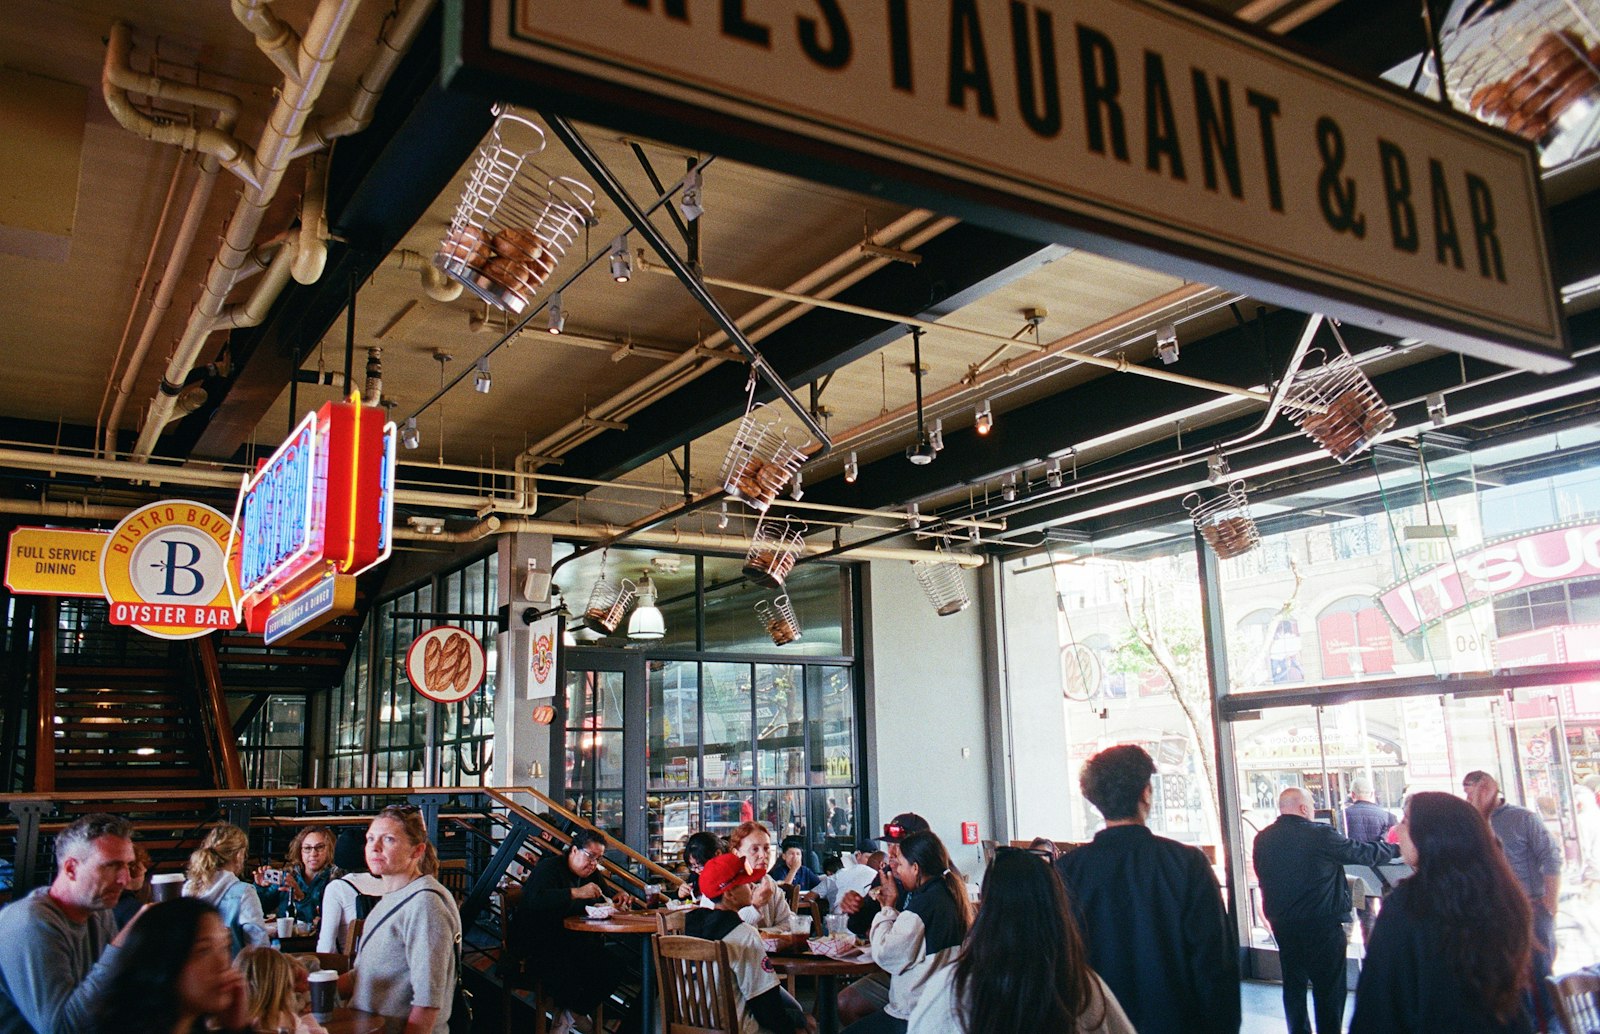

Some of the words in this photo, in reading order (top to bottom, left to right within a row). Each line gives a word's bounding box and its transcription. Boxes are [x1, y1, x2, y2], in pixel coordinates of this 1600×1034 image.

[620, 0, 1286, 214] TAURANT
[1315, 116, 1365, 239] &
[1377, 137, 1508, 284] BAR
[113, 507, 175, 554] BISTRO
[16, 545, 44, 559] FULL
[48, 547, 97, 562] SERVICE
[1418, 541, 1446, 562] EXIT
[35, 562, 76, 576] DINING
[156, 540, 205, 596] B
[116, 604, 186, 624] OYSTER
[194, 608, 230, 625] BAR
